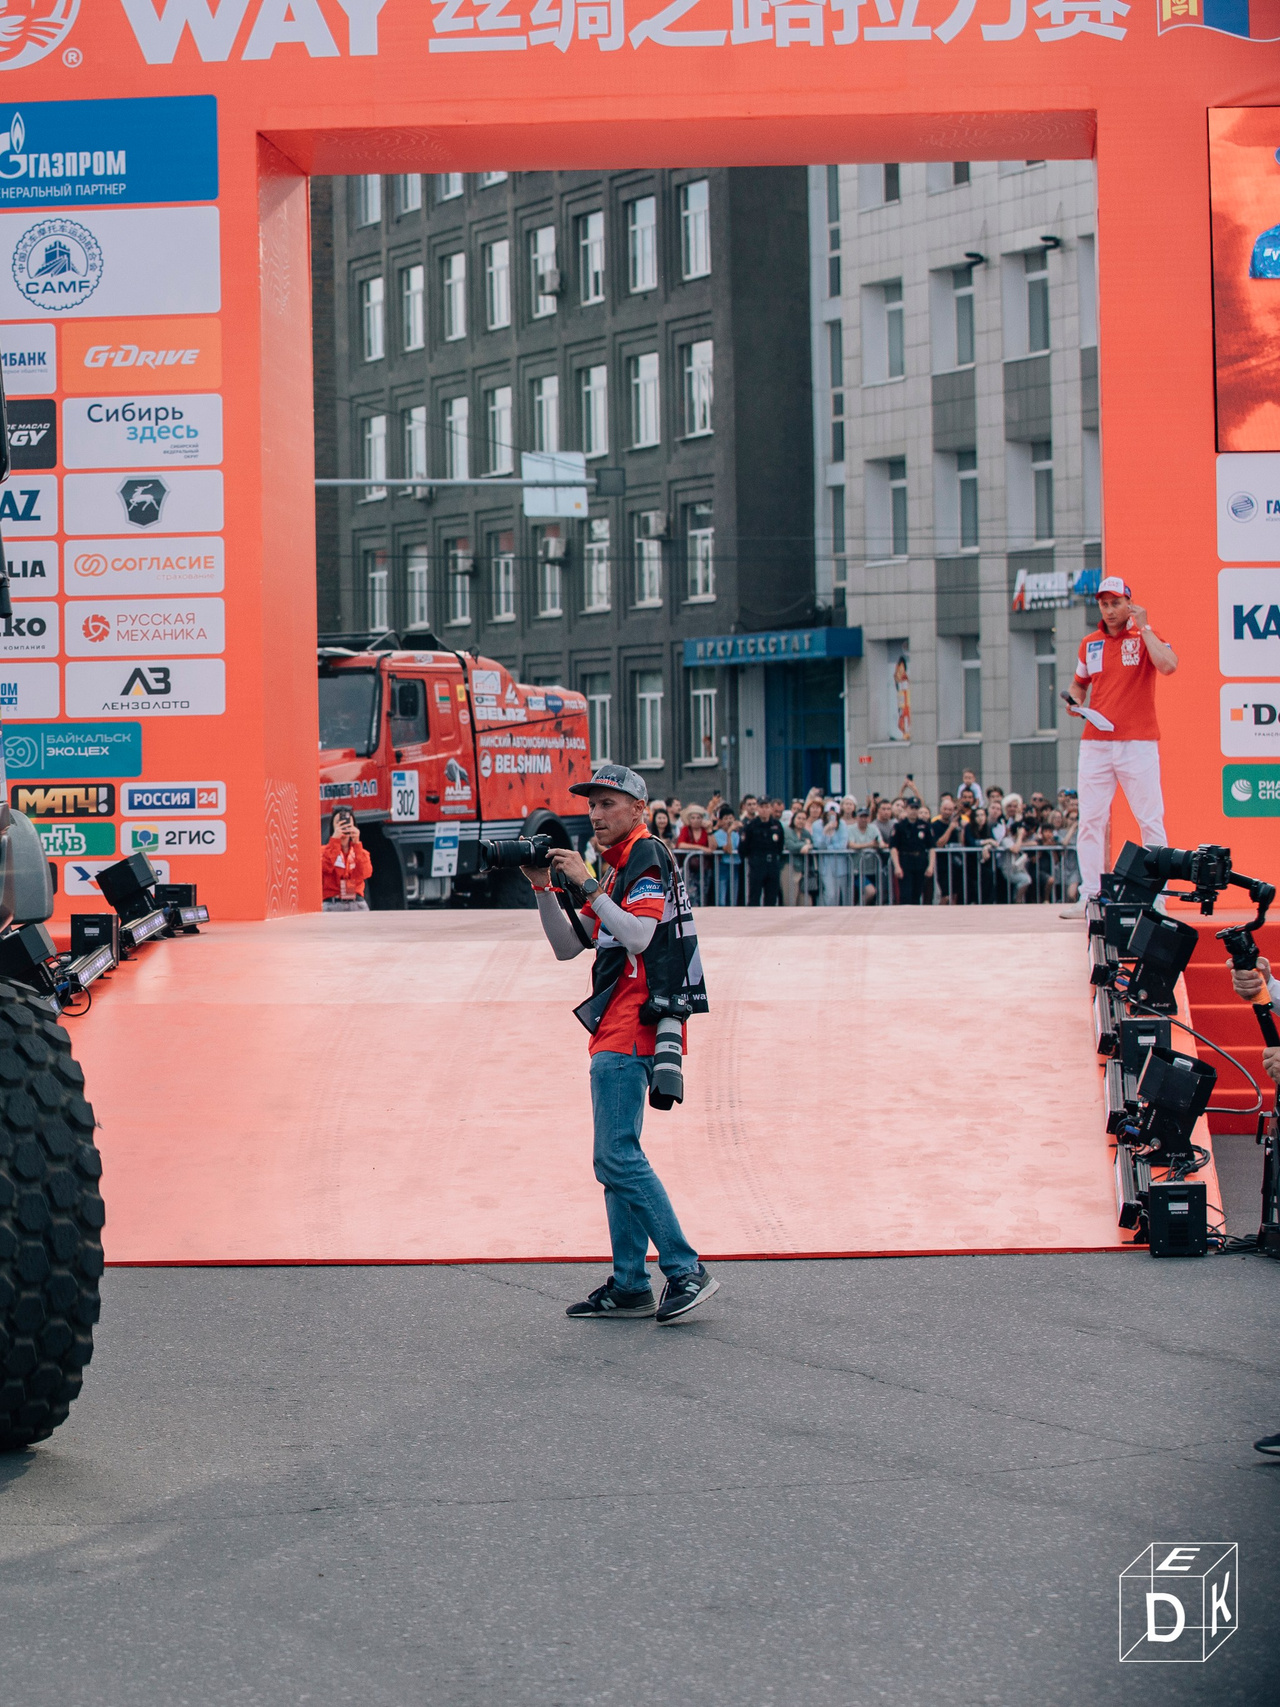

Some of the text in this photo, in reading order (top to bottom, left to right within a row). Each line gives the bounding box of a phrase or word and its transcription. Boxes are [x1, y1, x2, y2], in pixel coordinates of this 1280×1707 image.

[120, 0, 387, 64] WAY
[29, 150, 127, 179] ГАЗПРОМ
[74, 183, 127, 197] ПАРТНЕР
[25, 280, 90, 295] CAMF
[87, 402, 183, 426] Сибирь
[126, 424, 199, 444] здесь
[111, 556, 215, 572] СОГЛАСИЕ
[156, 572, 215, 580] страхование
[116, 612, 196, 627] РУССКАЯ
[117, 627, 208, 642] МЕХАНИКА
[696, 633, 813, 658] ИРКУТСКСТАТ
[101, 700, 190, 711] ЛЕНЗОЛОТО
[1252, 703, 1280, 725] D
[46, 732, 132, 744] БАЙКАЛЬСК
[479, 733, 587, 750] МИНСКИЙ АВТОМОБИЛЬНЫЙ ЗАВОД
[46, 746, 110, 757] ЭКО.ЦЕХ
[495, 754, 552, 774] BELSHINA
[133, 791, 218, 806] РОССИЯ 24
[396, 789, 416, 816] 302
[165, 831, 216, 845] 2ГИС
